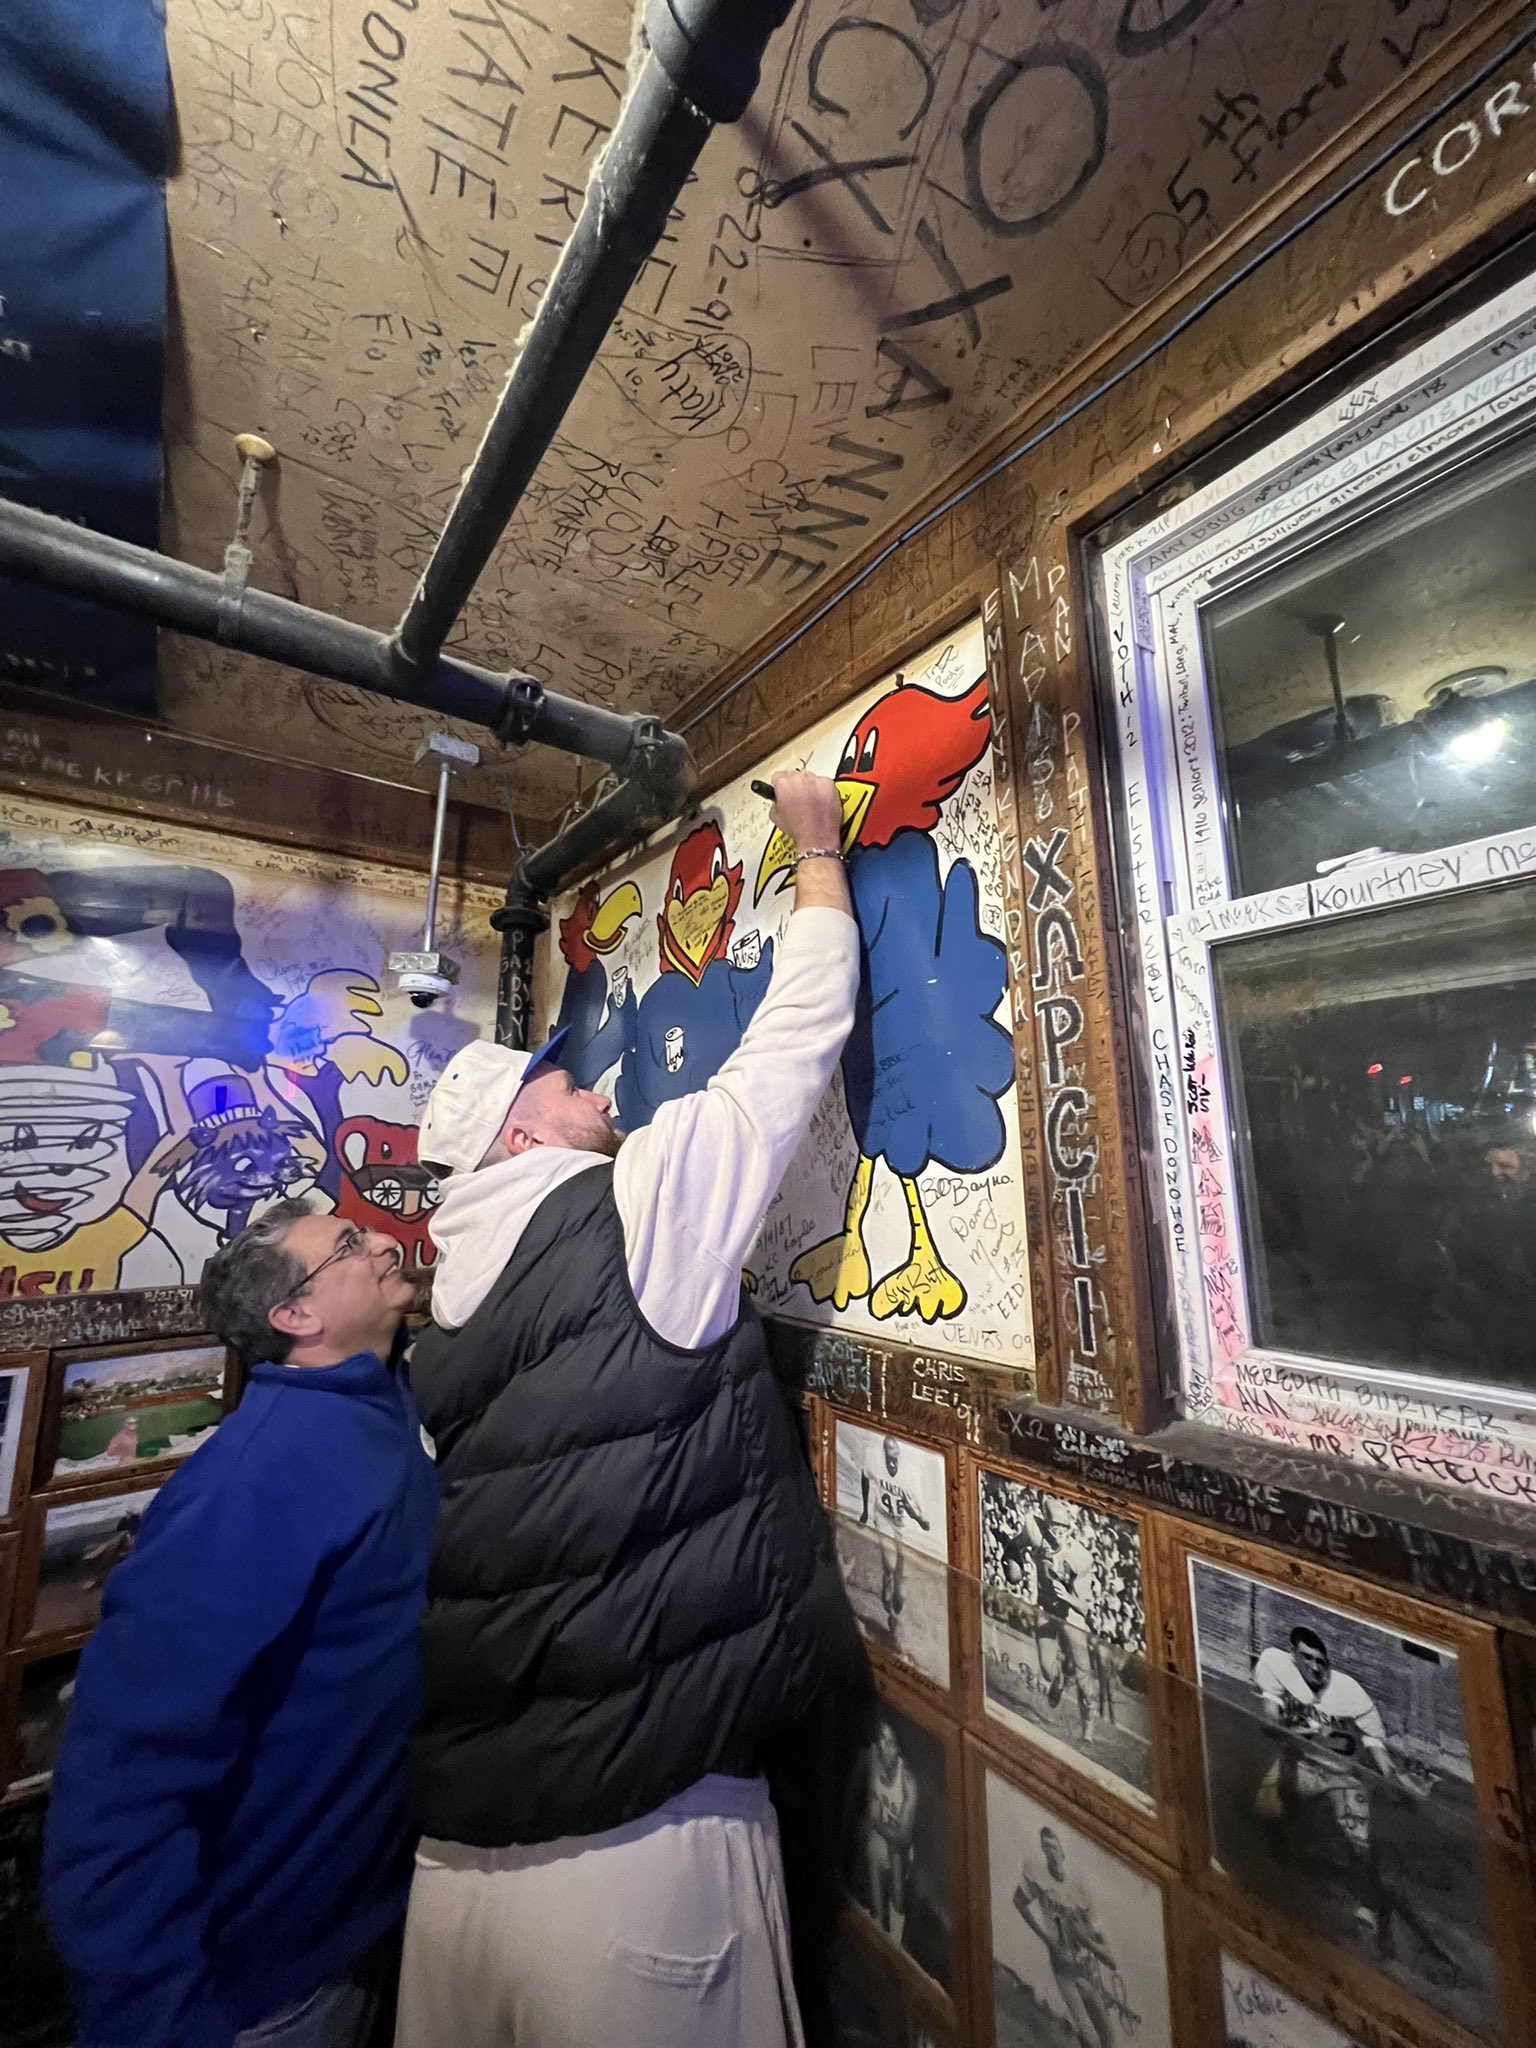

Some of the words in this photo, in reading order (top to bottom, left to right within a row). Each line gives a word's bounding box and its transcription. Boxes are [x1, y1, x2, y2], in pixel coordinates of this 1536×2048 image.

[341, 0, 419, 191] ONICA
[1385, 62, 1536, 215] COR
[1149, 538, 1187, 570] AMY
[510, 930, 526, 1043] PADDY
[1152, 1028, 1173, 1127] CHASE
[1163, 1137, 1187, 1253] DONOHOE
[910, 1380, 952, 1407] LEE
[912, 1356, 967, 1384] CHRIS
[1235, 1364, 1341, 1402] MEREDITH
